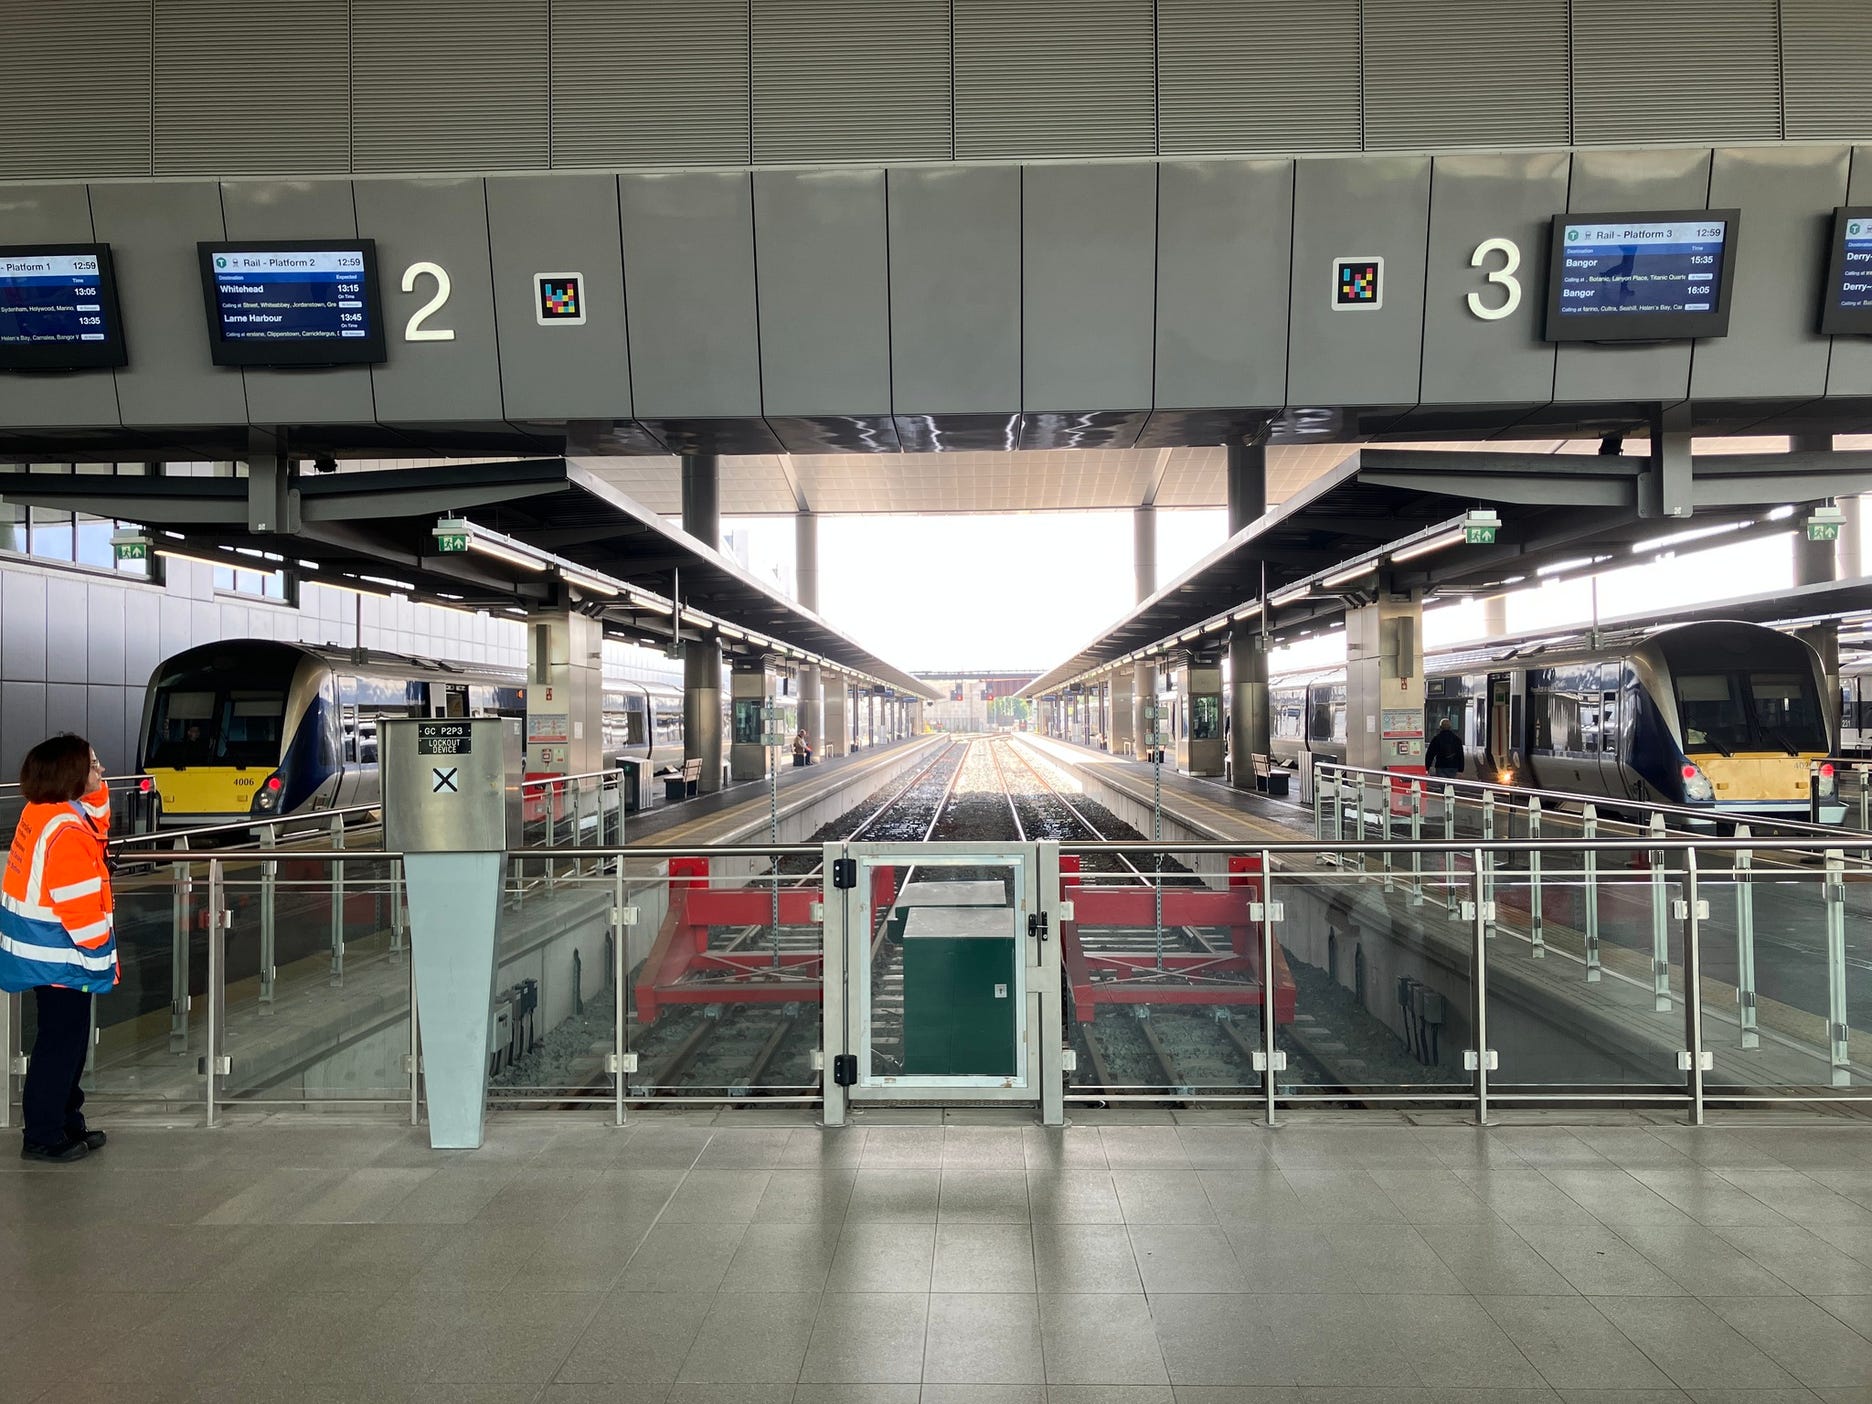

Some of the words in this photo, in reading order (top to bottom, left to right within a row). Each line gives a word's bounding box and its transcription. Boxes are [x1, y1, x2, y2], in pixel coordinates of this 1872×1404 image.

[1624, 230, 1664, 238] Platform
[1566, 259, 1598, 268] Bangor
[1468, 238, 1521, 320] 3
[1563, 289, 1595, 298] Bangor
[402, 262, 454, 340] 2
